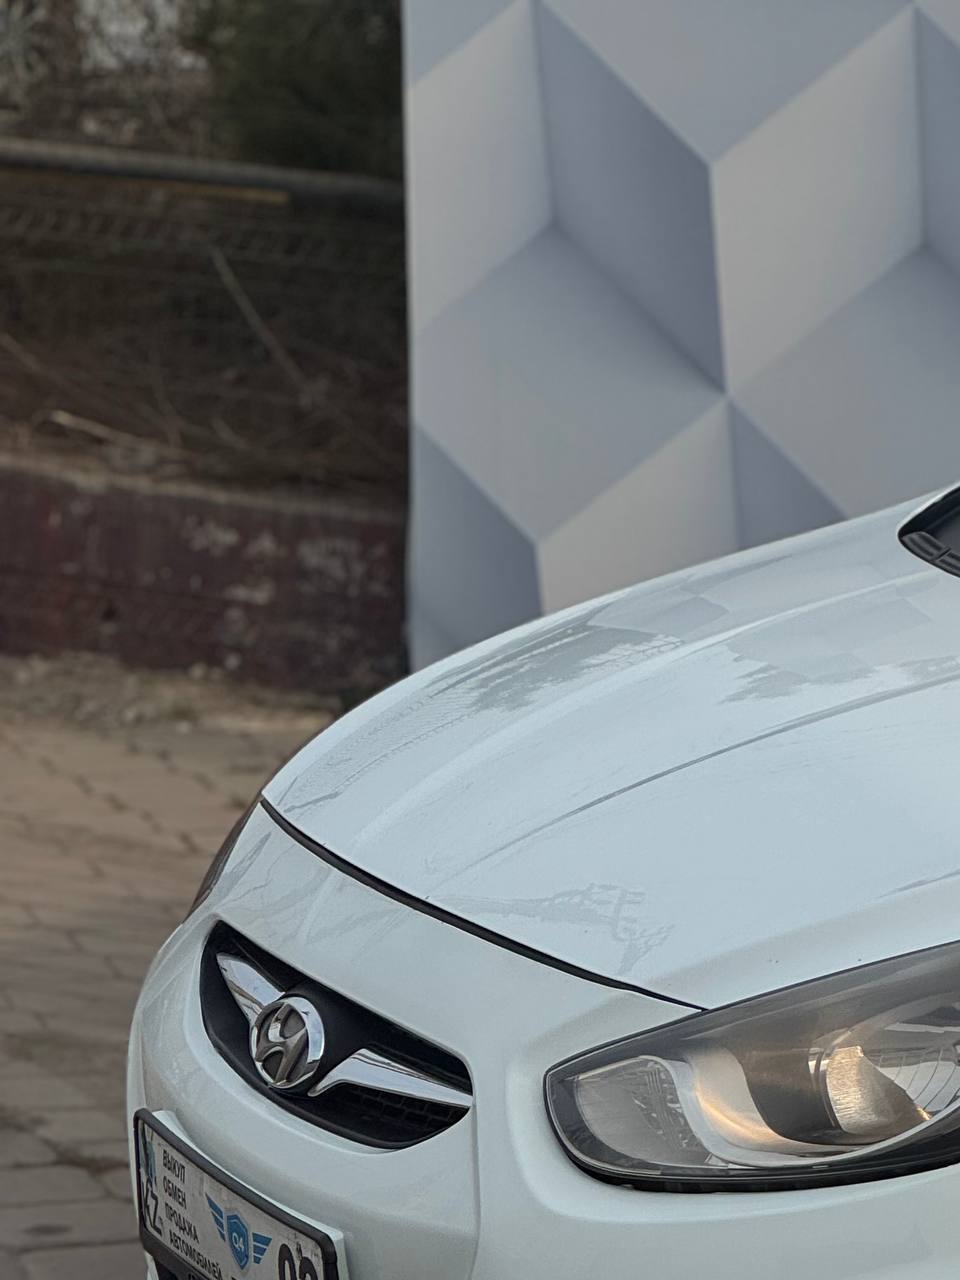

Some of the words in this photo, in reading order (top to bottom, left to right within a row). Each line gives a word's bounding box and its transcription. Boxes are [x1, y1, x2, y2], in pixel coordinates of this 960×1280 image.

[162, 1149, 186, 1184] ВЫКУП
[162, 1175, 187, 1209] ОБМЕН
[164, 1202, 200, 1244] ПРОДАЖА
